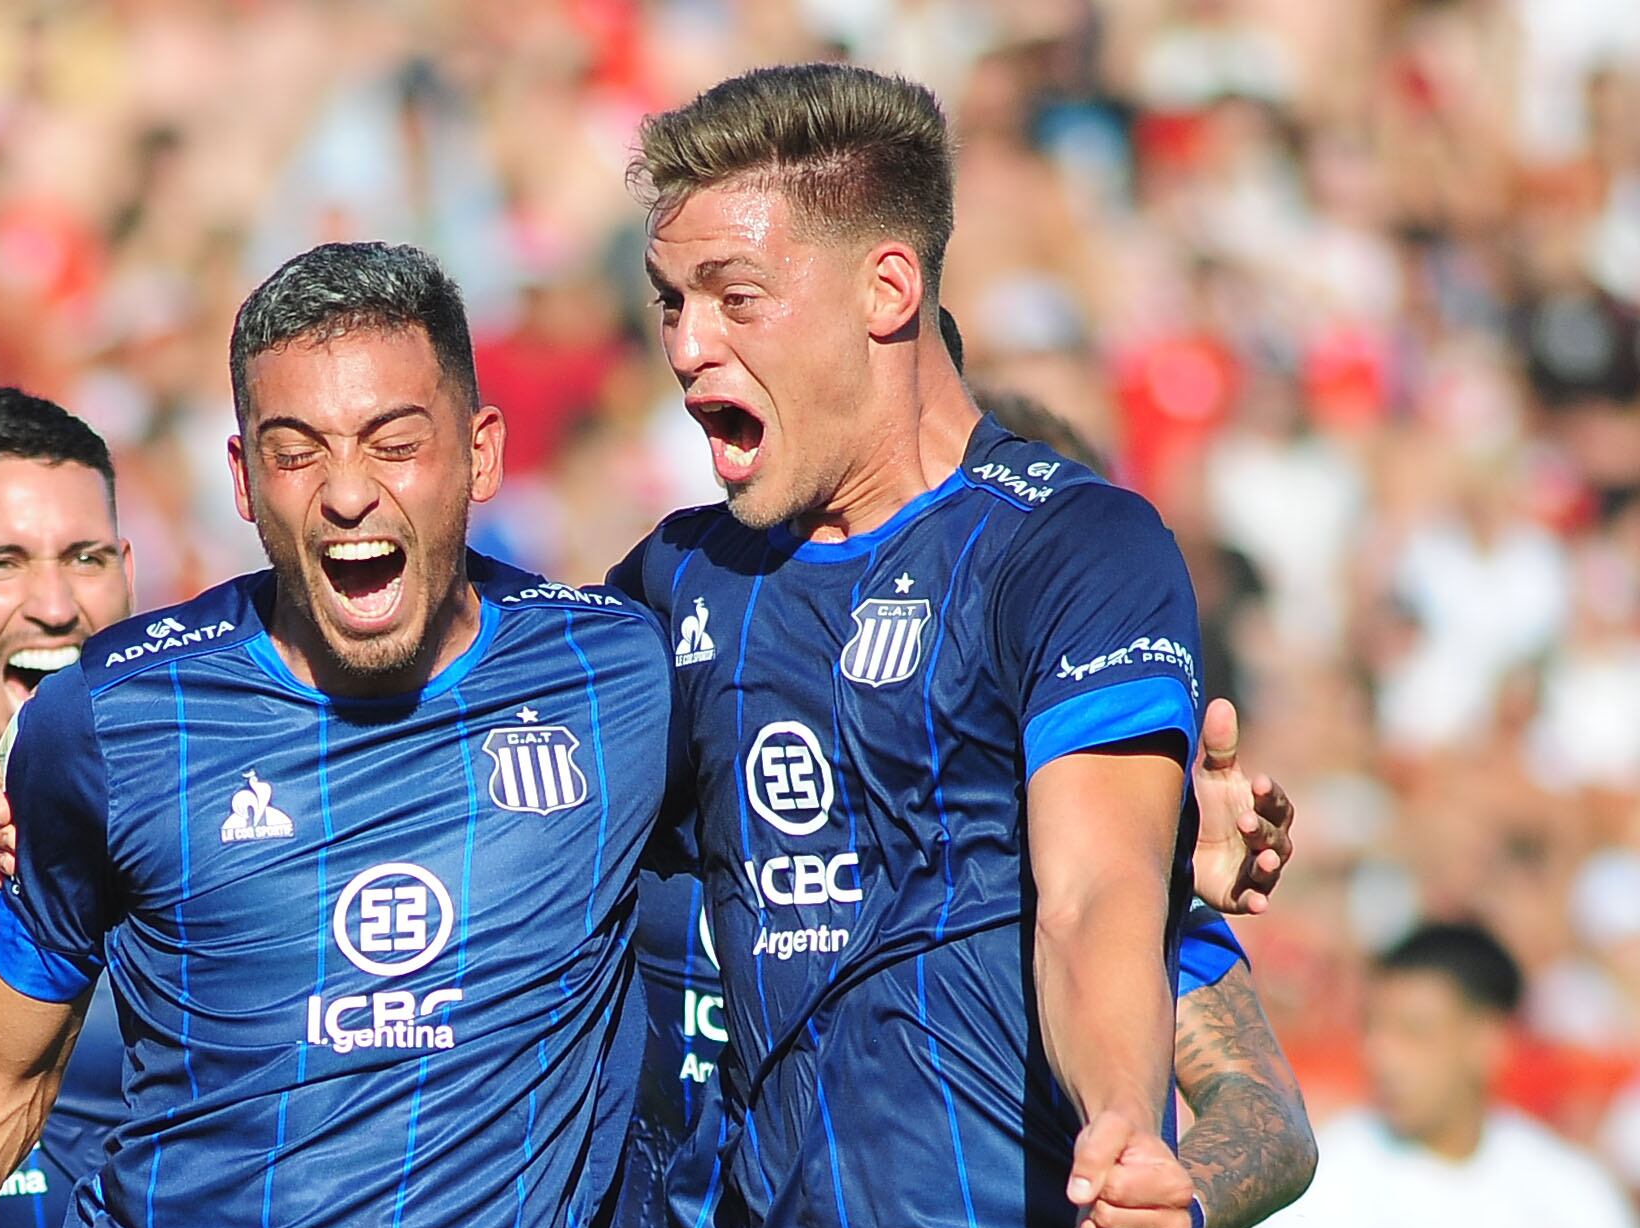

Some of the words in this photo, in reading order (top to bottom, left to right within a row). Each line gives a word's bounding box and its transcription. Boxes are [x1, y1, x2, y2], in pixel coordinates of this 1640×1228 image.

[502, 588, 623, 606] ADVANTA
[876, 605, 917, 617] C.A.T
[105, 620, 235, 668] ADVANTA
[506, 732, 552, 745] C.A.T
[744, 852, 863, 909] ICBC
[684, 989, 729, 1043] IC
